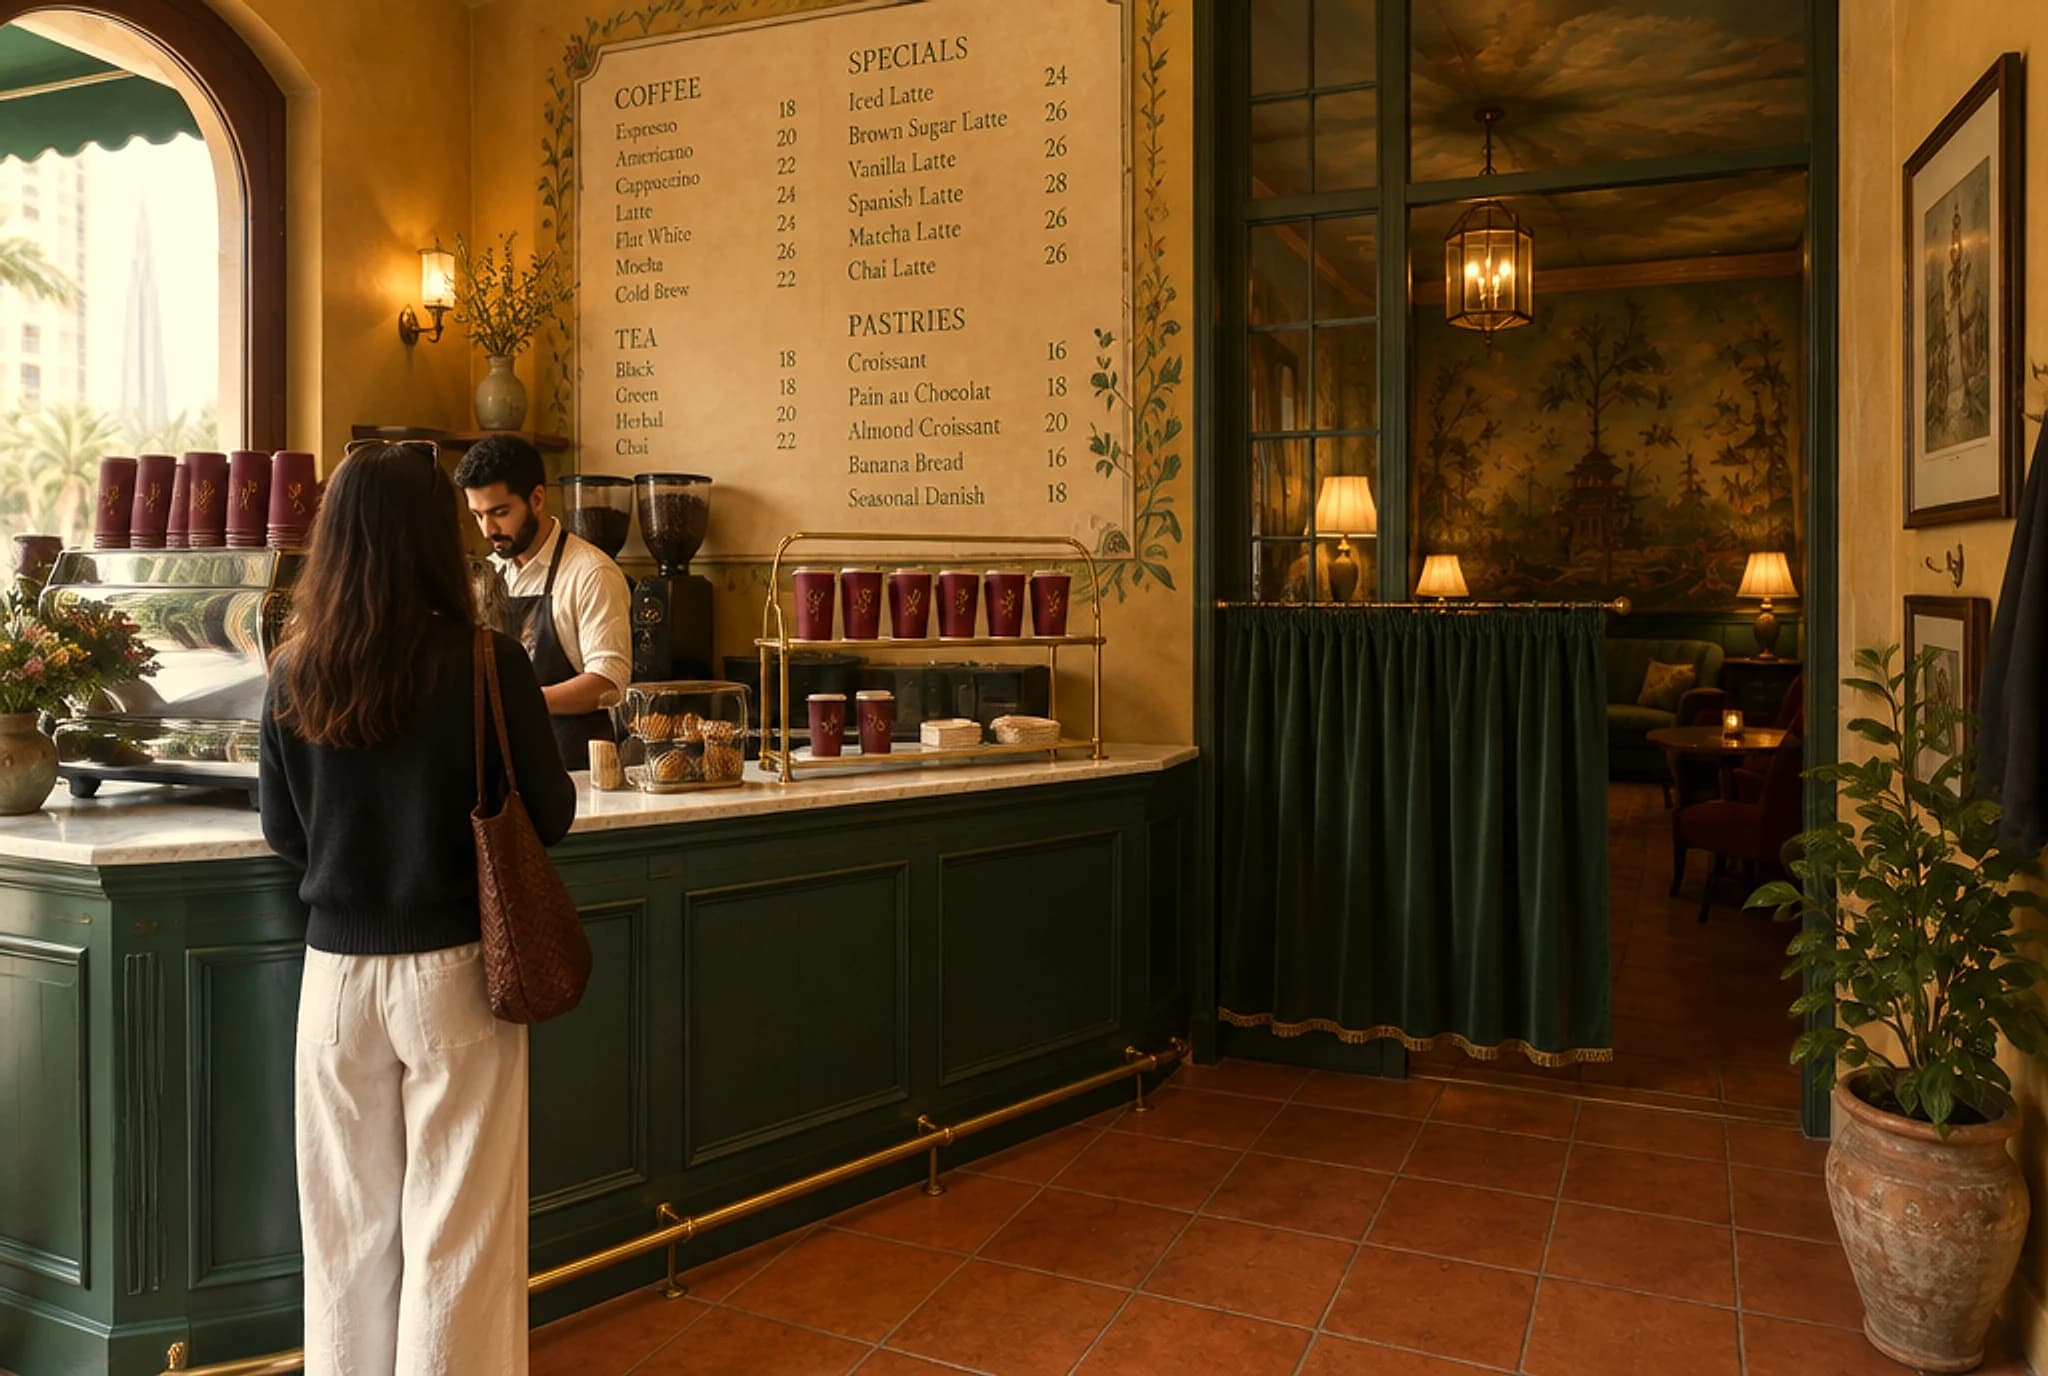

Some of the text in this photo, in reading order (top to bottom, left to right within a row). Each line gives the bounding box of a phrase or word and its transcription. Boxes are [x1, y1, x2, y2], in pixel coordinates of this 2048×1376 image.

[848, 36, 968, 75] SPECIALS
[614, 76, 701, 109] COFFEE
[849, 66, 1068, 111] Iced Latte 24
[778, 100, 795, 118] 18
[849, 101, 1067, 145] Brown Sugar Latte 26
[616, 128, 796, 167] Americano 20
[848, 136, 1067, 178] Vanilla Latte 26
[777, 157, 795, 174] 22
[616, 186, 795, 222] Latte 24
[848, 172, 1068, 216] Spanish Latte 28
[616, 215, 795, 249] Flat White 24
[849, 207, 1067, 247] Matcha Latte 26
[616, 243, 795, 276] Mocha 26
[848, 244, 1067, 281] Chai Latte 26
[616, 271, 795, 303] Cold Brew 22
[848, 307, 966, 337] PASTRIES
[615, 328, 658, 349] TEA
[616, 351, 796, 378] Black 18
[848, 341, 1067, 373] Croissant 16
[616, 378, 796, 404] Green 18
[849, 376, 1067, 406] Pain au Chocolat 18
[616, 406, 796, 430] Herbal 20
[848, 412, 1068, 441] Almond Croissant 20
[616, 432, 796, 455] Chai 22
[849, 447, 1067, 474] Banana Bread 16
[849, 482, 1067, 507] Seasonal Danish 18
